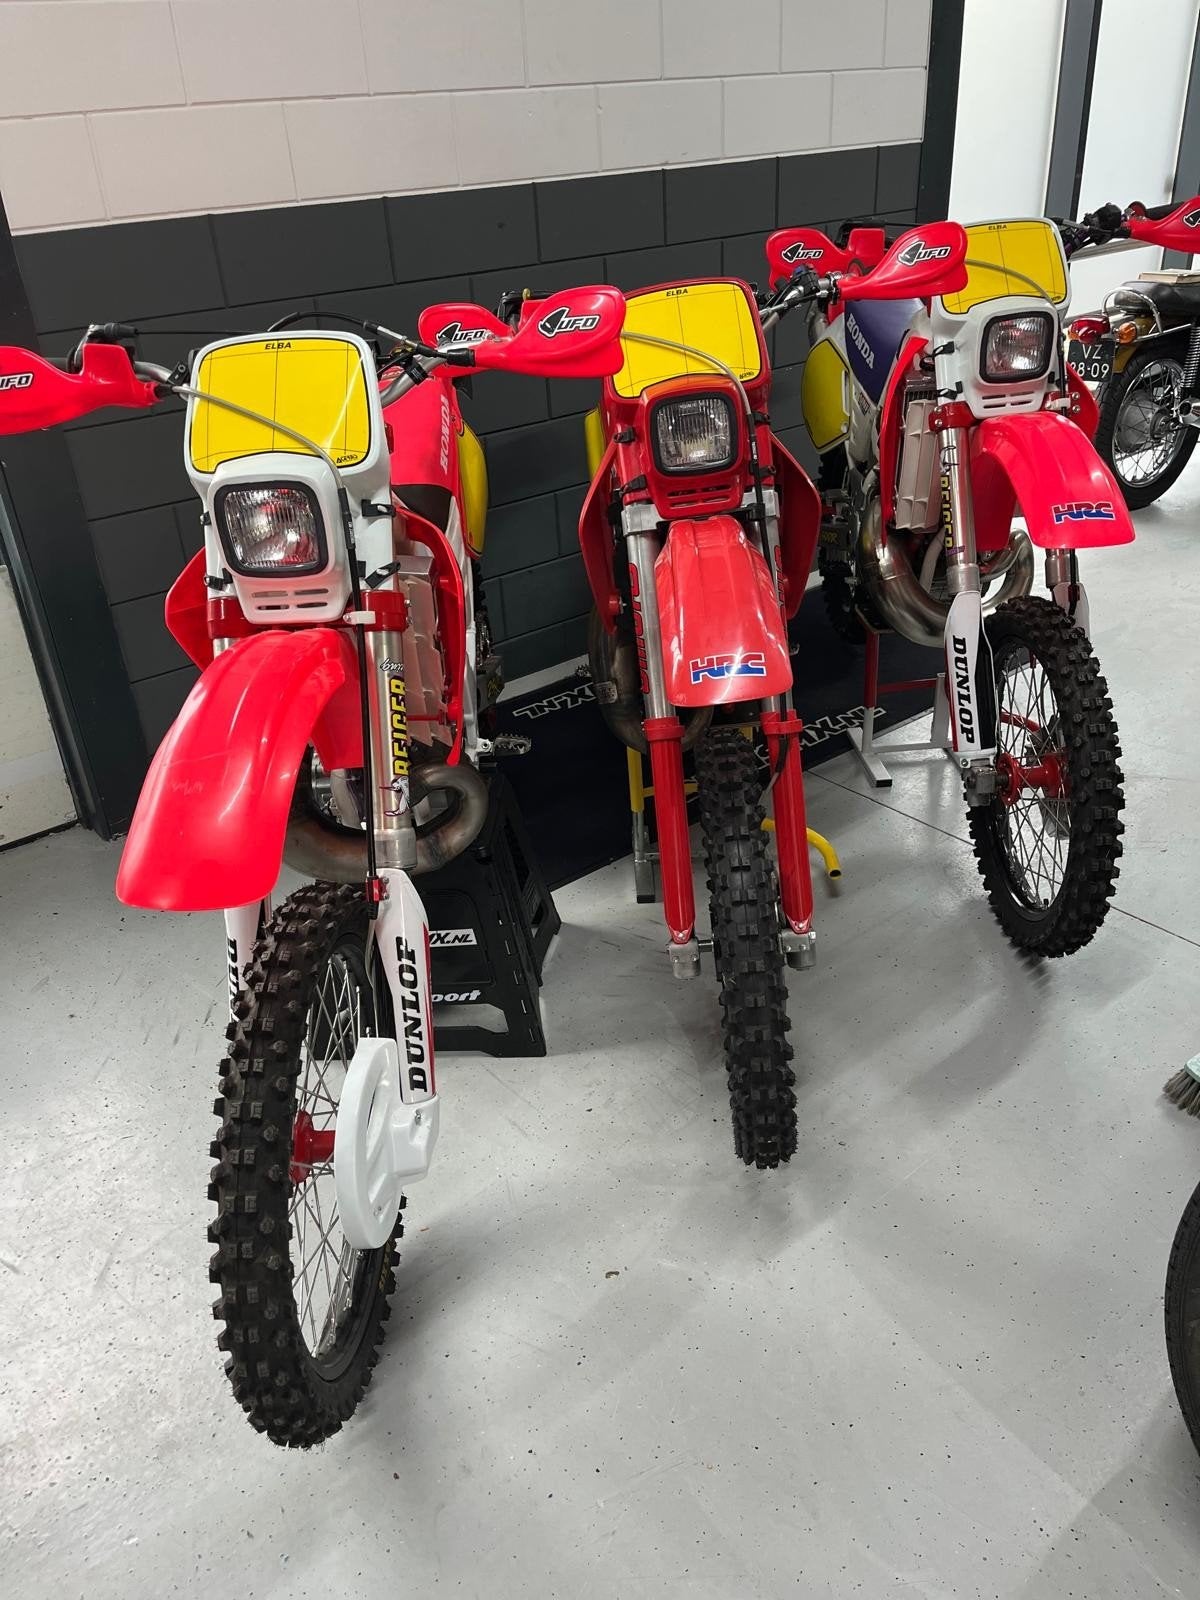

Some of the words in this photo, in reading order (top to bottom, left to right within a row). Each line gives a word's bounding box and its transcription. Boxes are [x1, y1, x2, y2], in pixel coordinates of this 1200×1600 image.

[795, 249, 823, 260] UFO
[916, 247, 951, 261] UFO
[556, 316, 600, 332] UFO
[452, 329, 486, 343] UFO
[846, 313, 875, 369] HONDA
[264, 342, 292, 350] ELBA
[1082, 343, 1103, 360] VZ
[440, 393, 450, 475] HONDA
[1052, 502, 1116, 525] HRC
[689, 652, 767, 684] HRC
[952, 635, 975, 744] DUNLOP
[431, 989, 482, 1003] port
[396, 936, 427, 1093] DUNLOP
